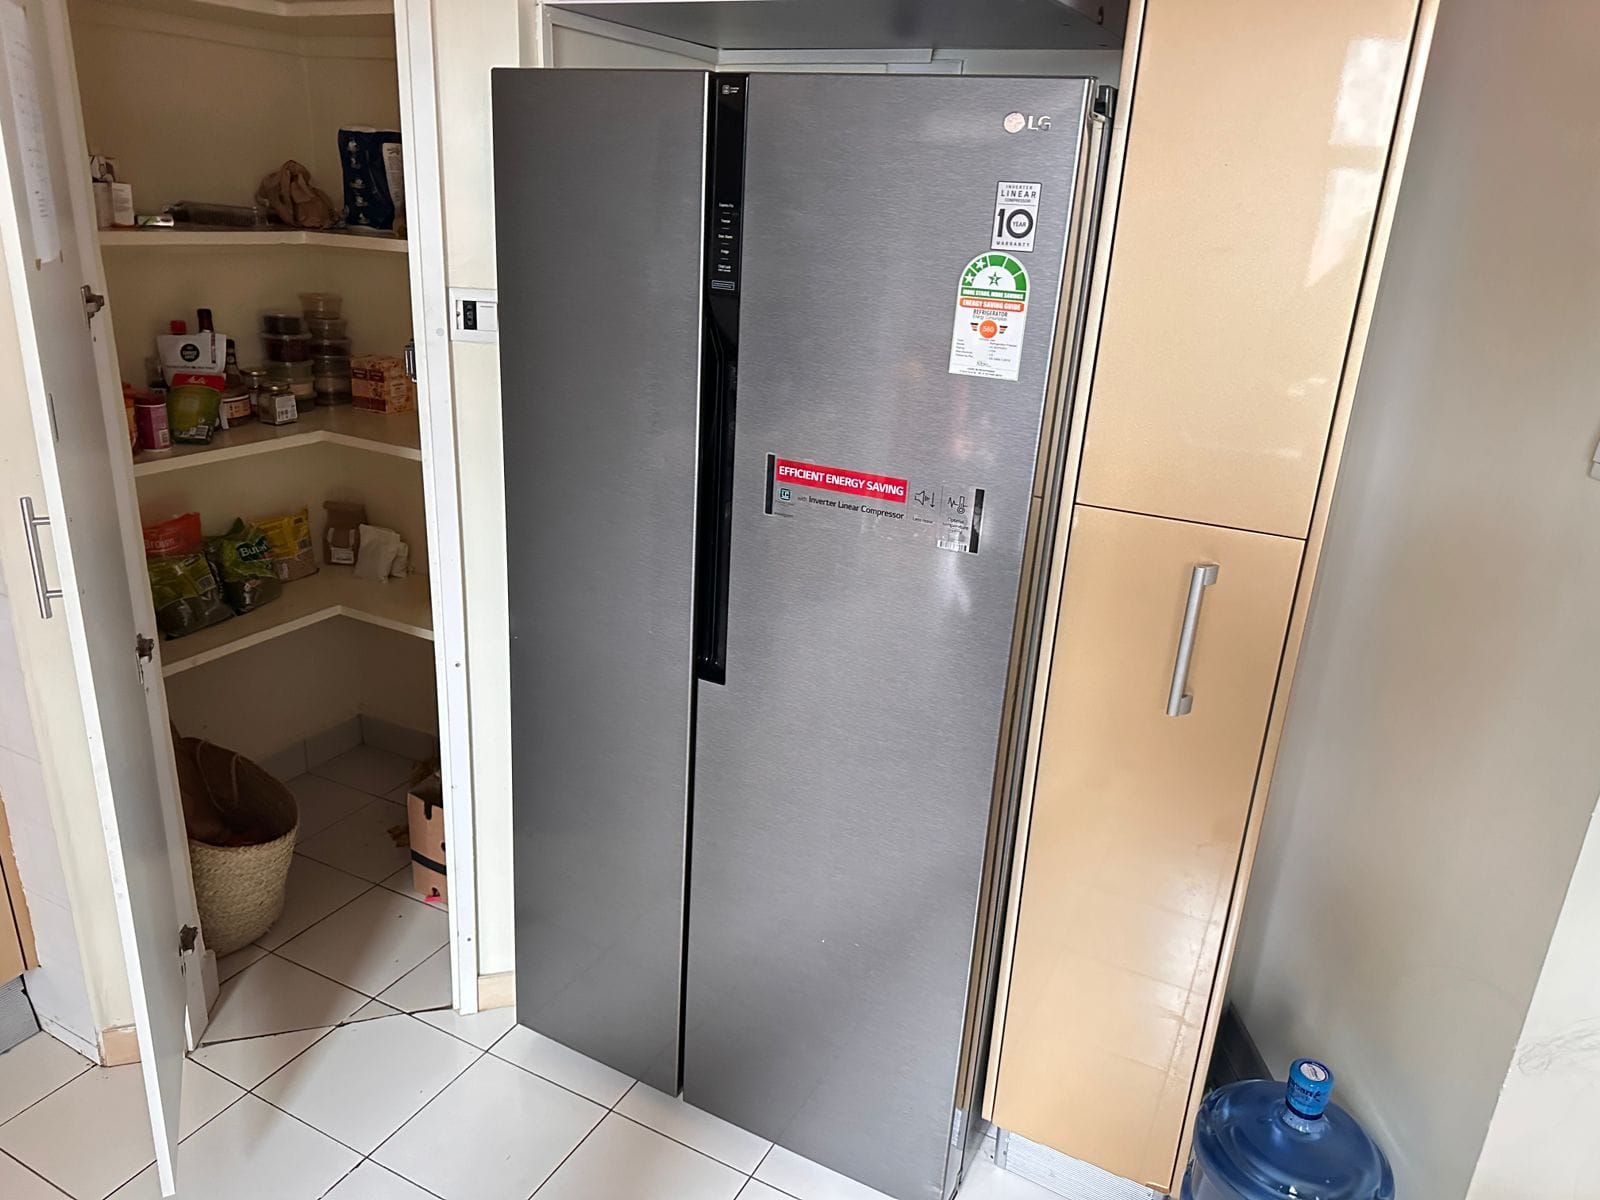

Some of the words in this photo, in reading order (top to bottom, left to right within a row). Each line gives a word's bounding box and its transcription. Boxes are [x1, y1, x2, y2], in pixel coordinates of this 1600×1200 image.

[1027, 115, 1051, 131] LG
[1000, 190, 1037, 199] LINEAR
[997, 208, 1034, 239] 10
[973, 308, 1008, 317] REFRIGERATOR
[778, 465, 825, 482] EFFICIENT
[825, 474, 866, 489] ENERGY
[866, 481, 904, 496] SAVING
[808, 495, 837, 507] Inverter
[838, 501, 859, 511] Linear
[860, 505, 904, 520] Compressor
